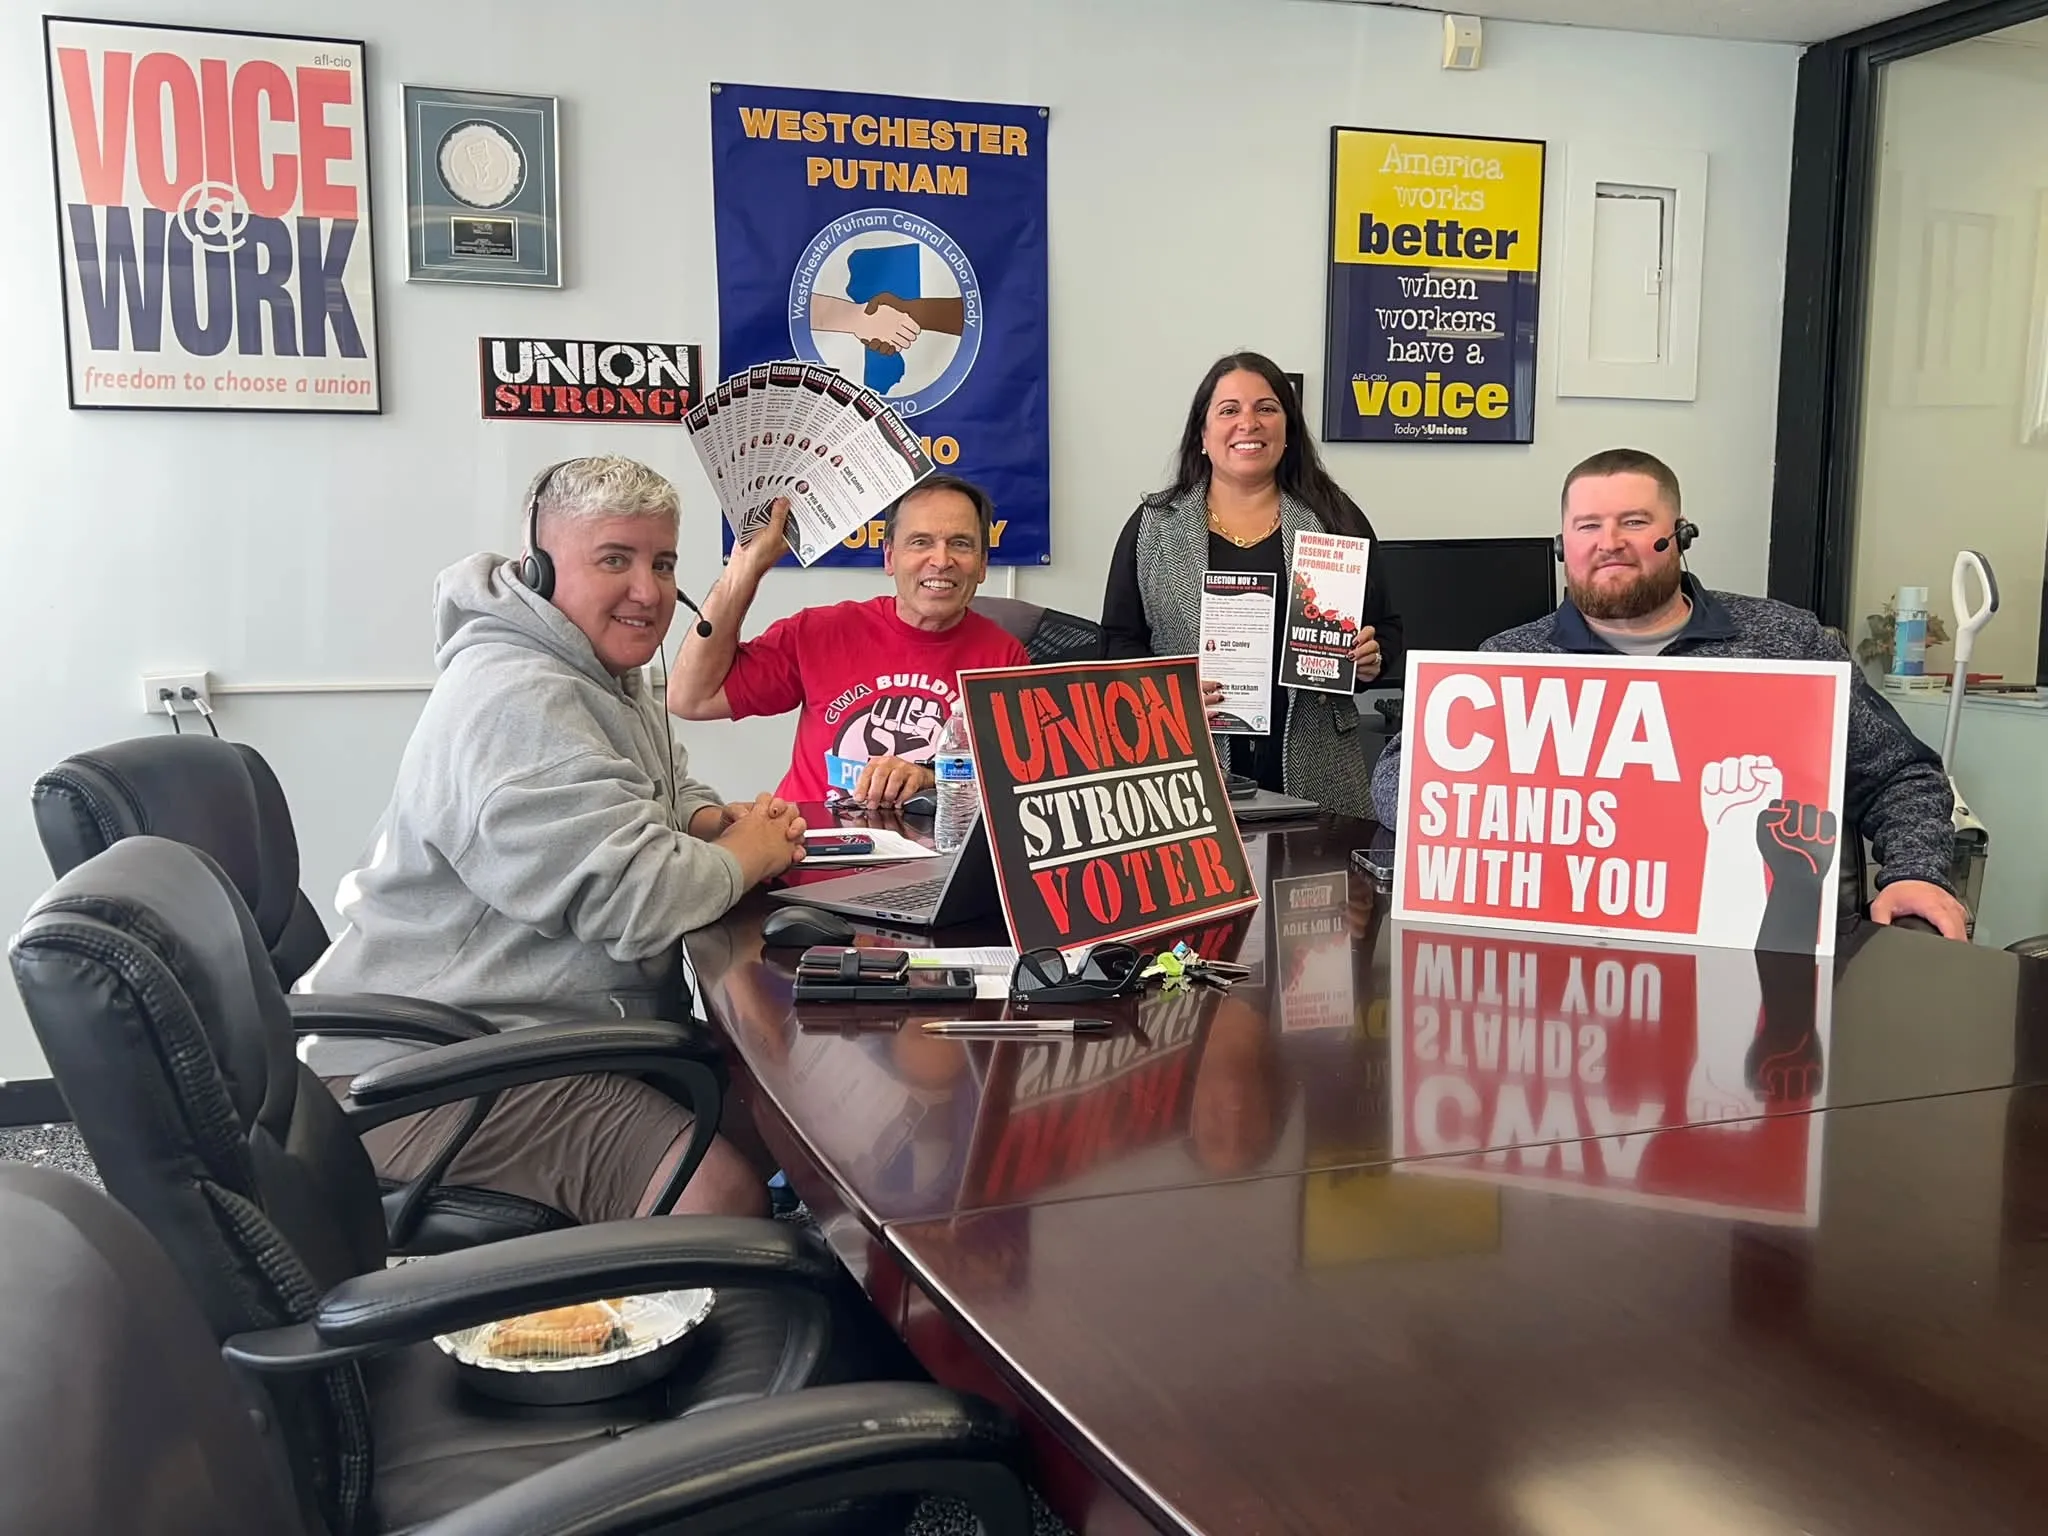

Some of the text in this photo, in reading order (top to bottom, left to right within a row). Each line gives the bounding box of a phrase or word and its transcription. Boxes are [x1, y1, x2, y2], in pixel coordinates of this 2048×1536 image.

[313, 53, 352, 68] afl-cio
[57, 48, 359, 220] VOICE
[739, 107, 1028, 156] WESTCHESTER
[807, 157, 968, 195] PUTNAM
[1379, 143, 1504, 179] America
[1394, 185, 1485, 212] works
[1359, 213, 1518, 260] better
[67, 204, 367, 359] WORK
[893, 215, 945, 247] Central
[943, 243, 971, 286] Labor
[964, 290, 981, 328] Body
[1398, 273, 1479, 300] when
[1375, 307, 1496, 332] workers
[492, 341, 690, 386] UNION
[1387, 337, 1484, 364] have a
[85, 365, 372, 395] freedom to choose a union
[1352, 372, 1509, 419] voice
[495, 385, 689, 415] STRONG!
[1299, 547, 1344, 560] DESERVE AN
[1300, 534, 1364, 551] WORKING PEOPLE
[1206, 575, 1258, 585] ELECTION NOV 3
[1298, 559, 1361, 574] AFFORDABLE LIFE
[1292, 626, 1353, 647] VOTE FOR IT
[1300, 667, 1335, 677] STRONG!
[1301, 656, 1335, 669] UNION
[825, 683, 873, 725] CWA
[990, 674, 1194, 783] UNION
[1423, 673, 1681, 782] CWA
[1018, 770, 1213, 858] STRONG!
[1419, 781, 1617, 848] STANDS
[1032, 836, 1235, 935] VOTER
[1417, 845, 1668, 919] WITH YOU
